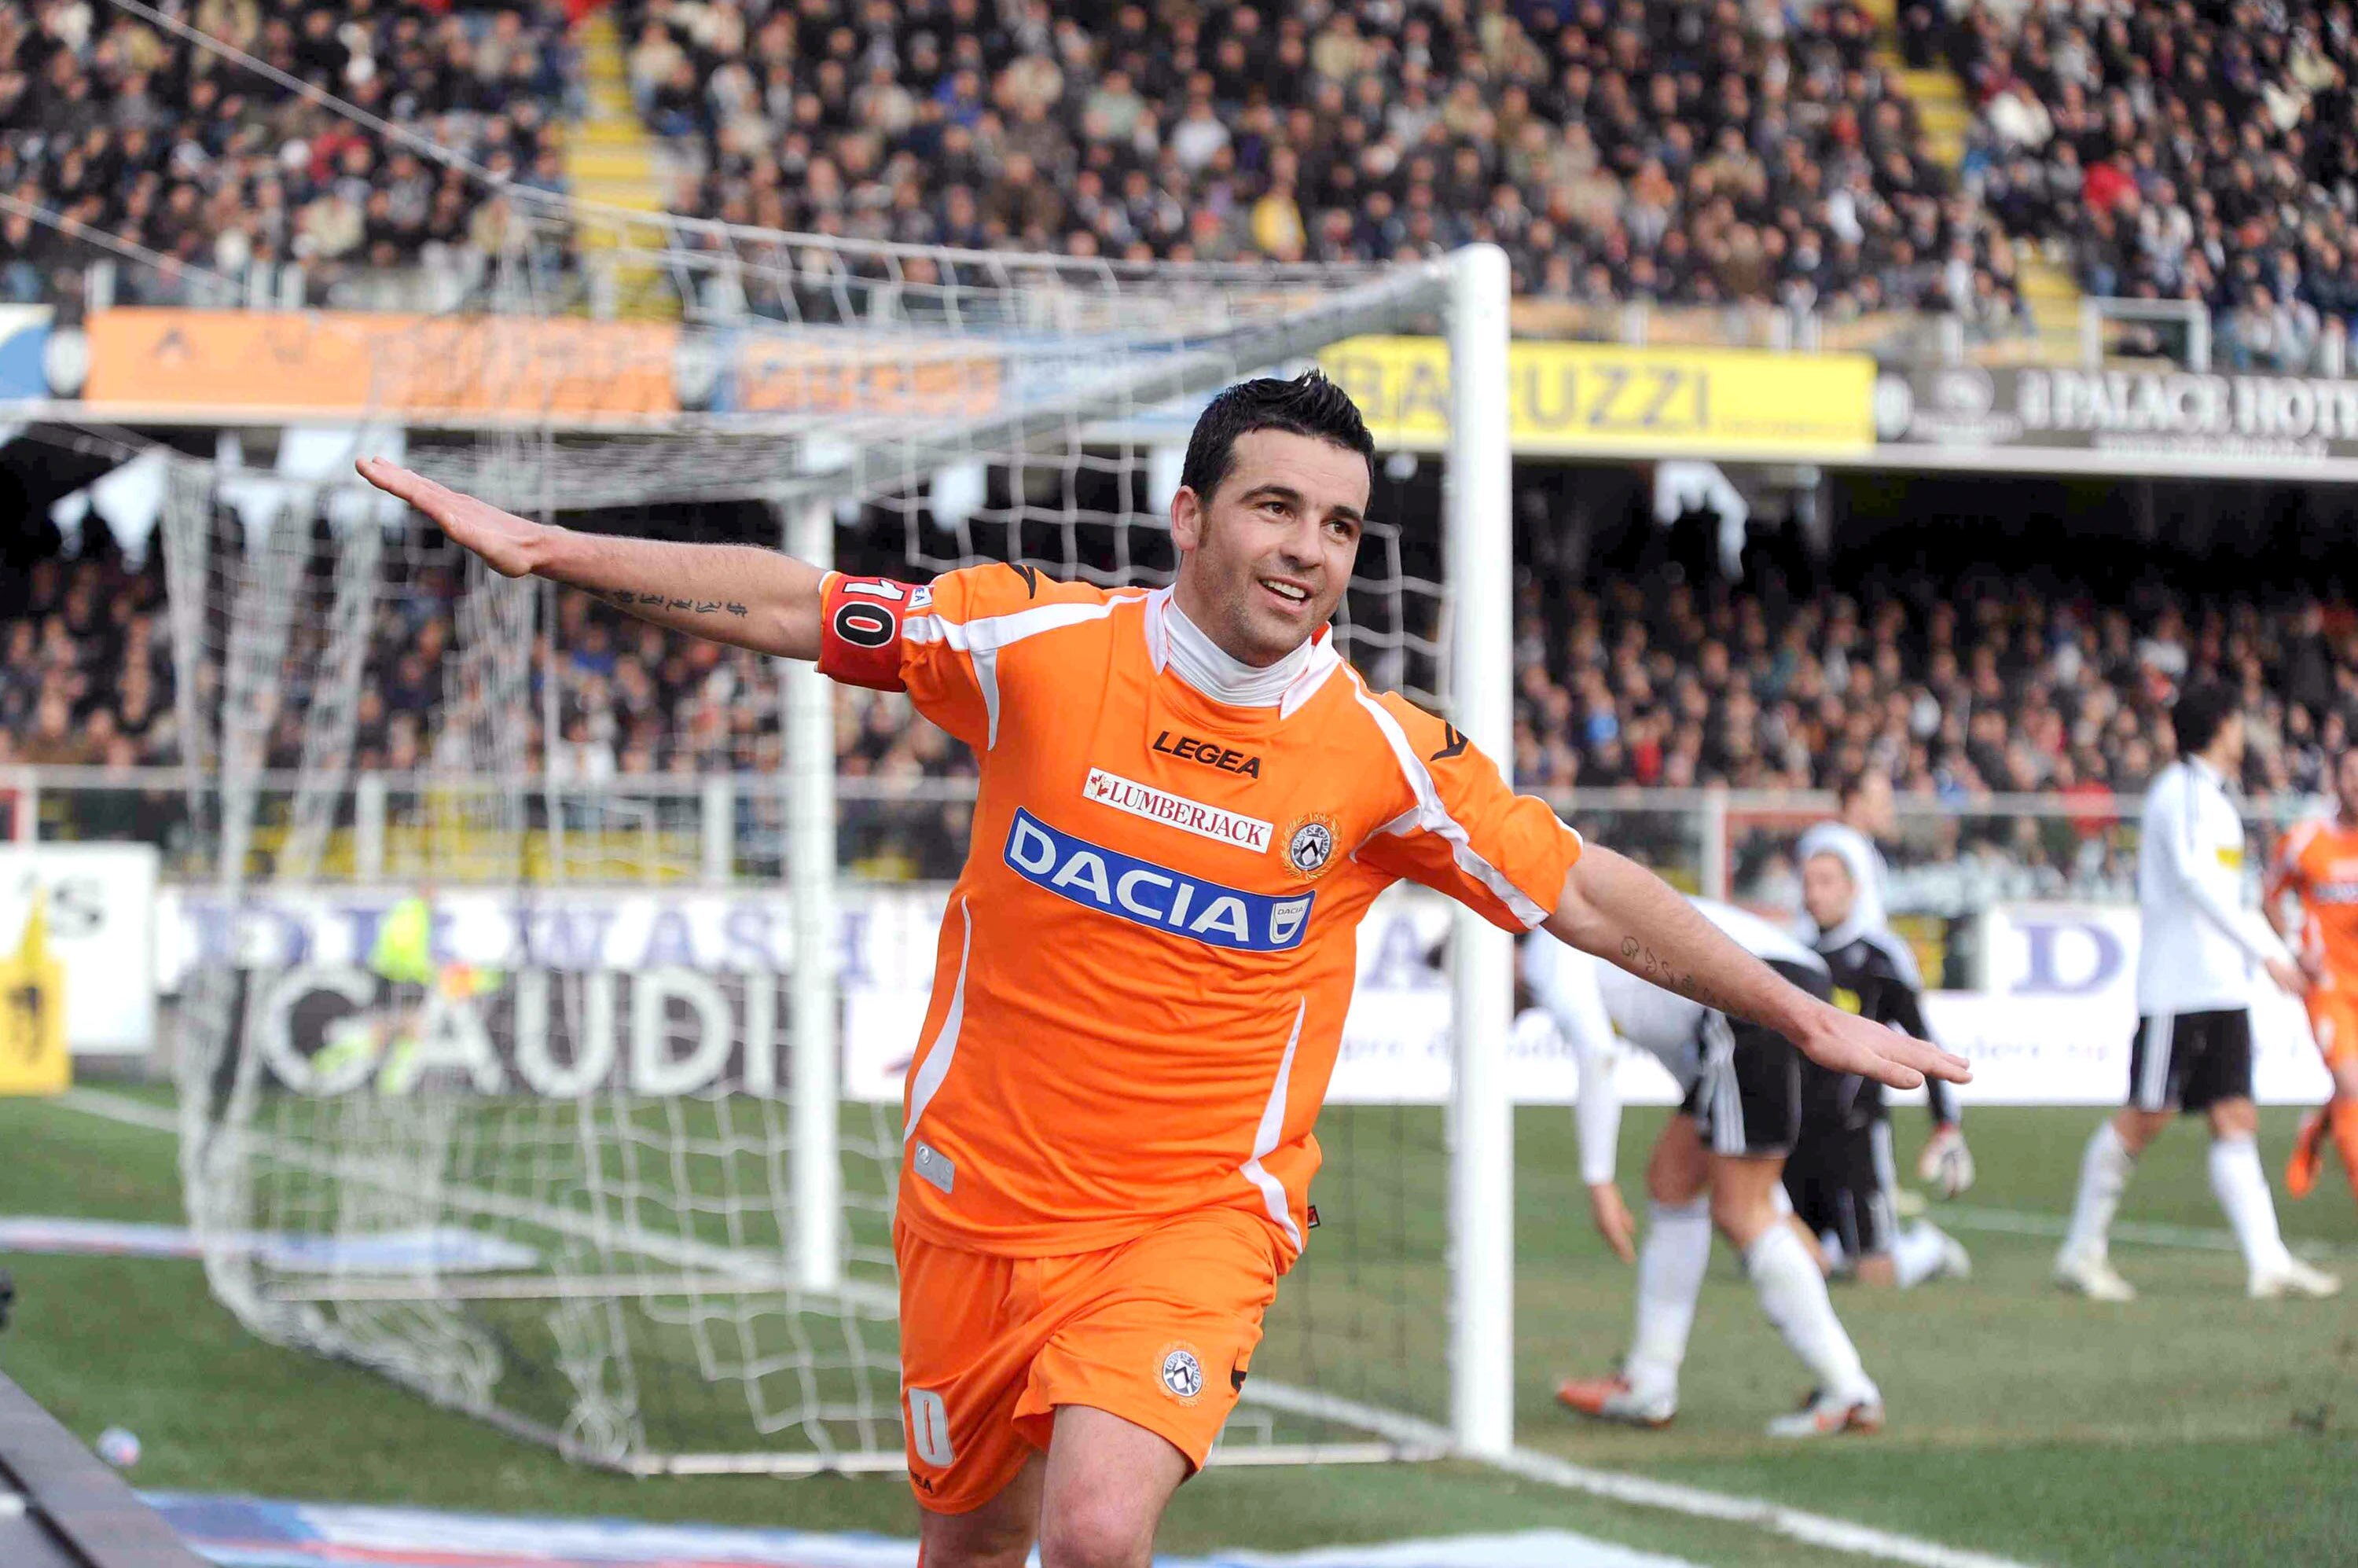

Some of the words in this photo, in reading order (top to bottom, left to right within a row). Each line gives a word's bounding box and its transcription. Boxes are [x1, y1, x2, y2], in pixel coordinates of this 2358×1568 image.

[1338, 356, 1710, 431] BAUZZI
[834, 578, 905, 648] 10
[1151, 730, 1262, 780] LEGEA
[1108, 780, 1267, 846] LUMBERJACK
[1001, 817, 1250, 942] DACIA
[1276, 906, 1304, 916] DACIA
[263, 967, 777, 1096] GAUDI
